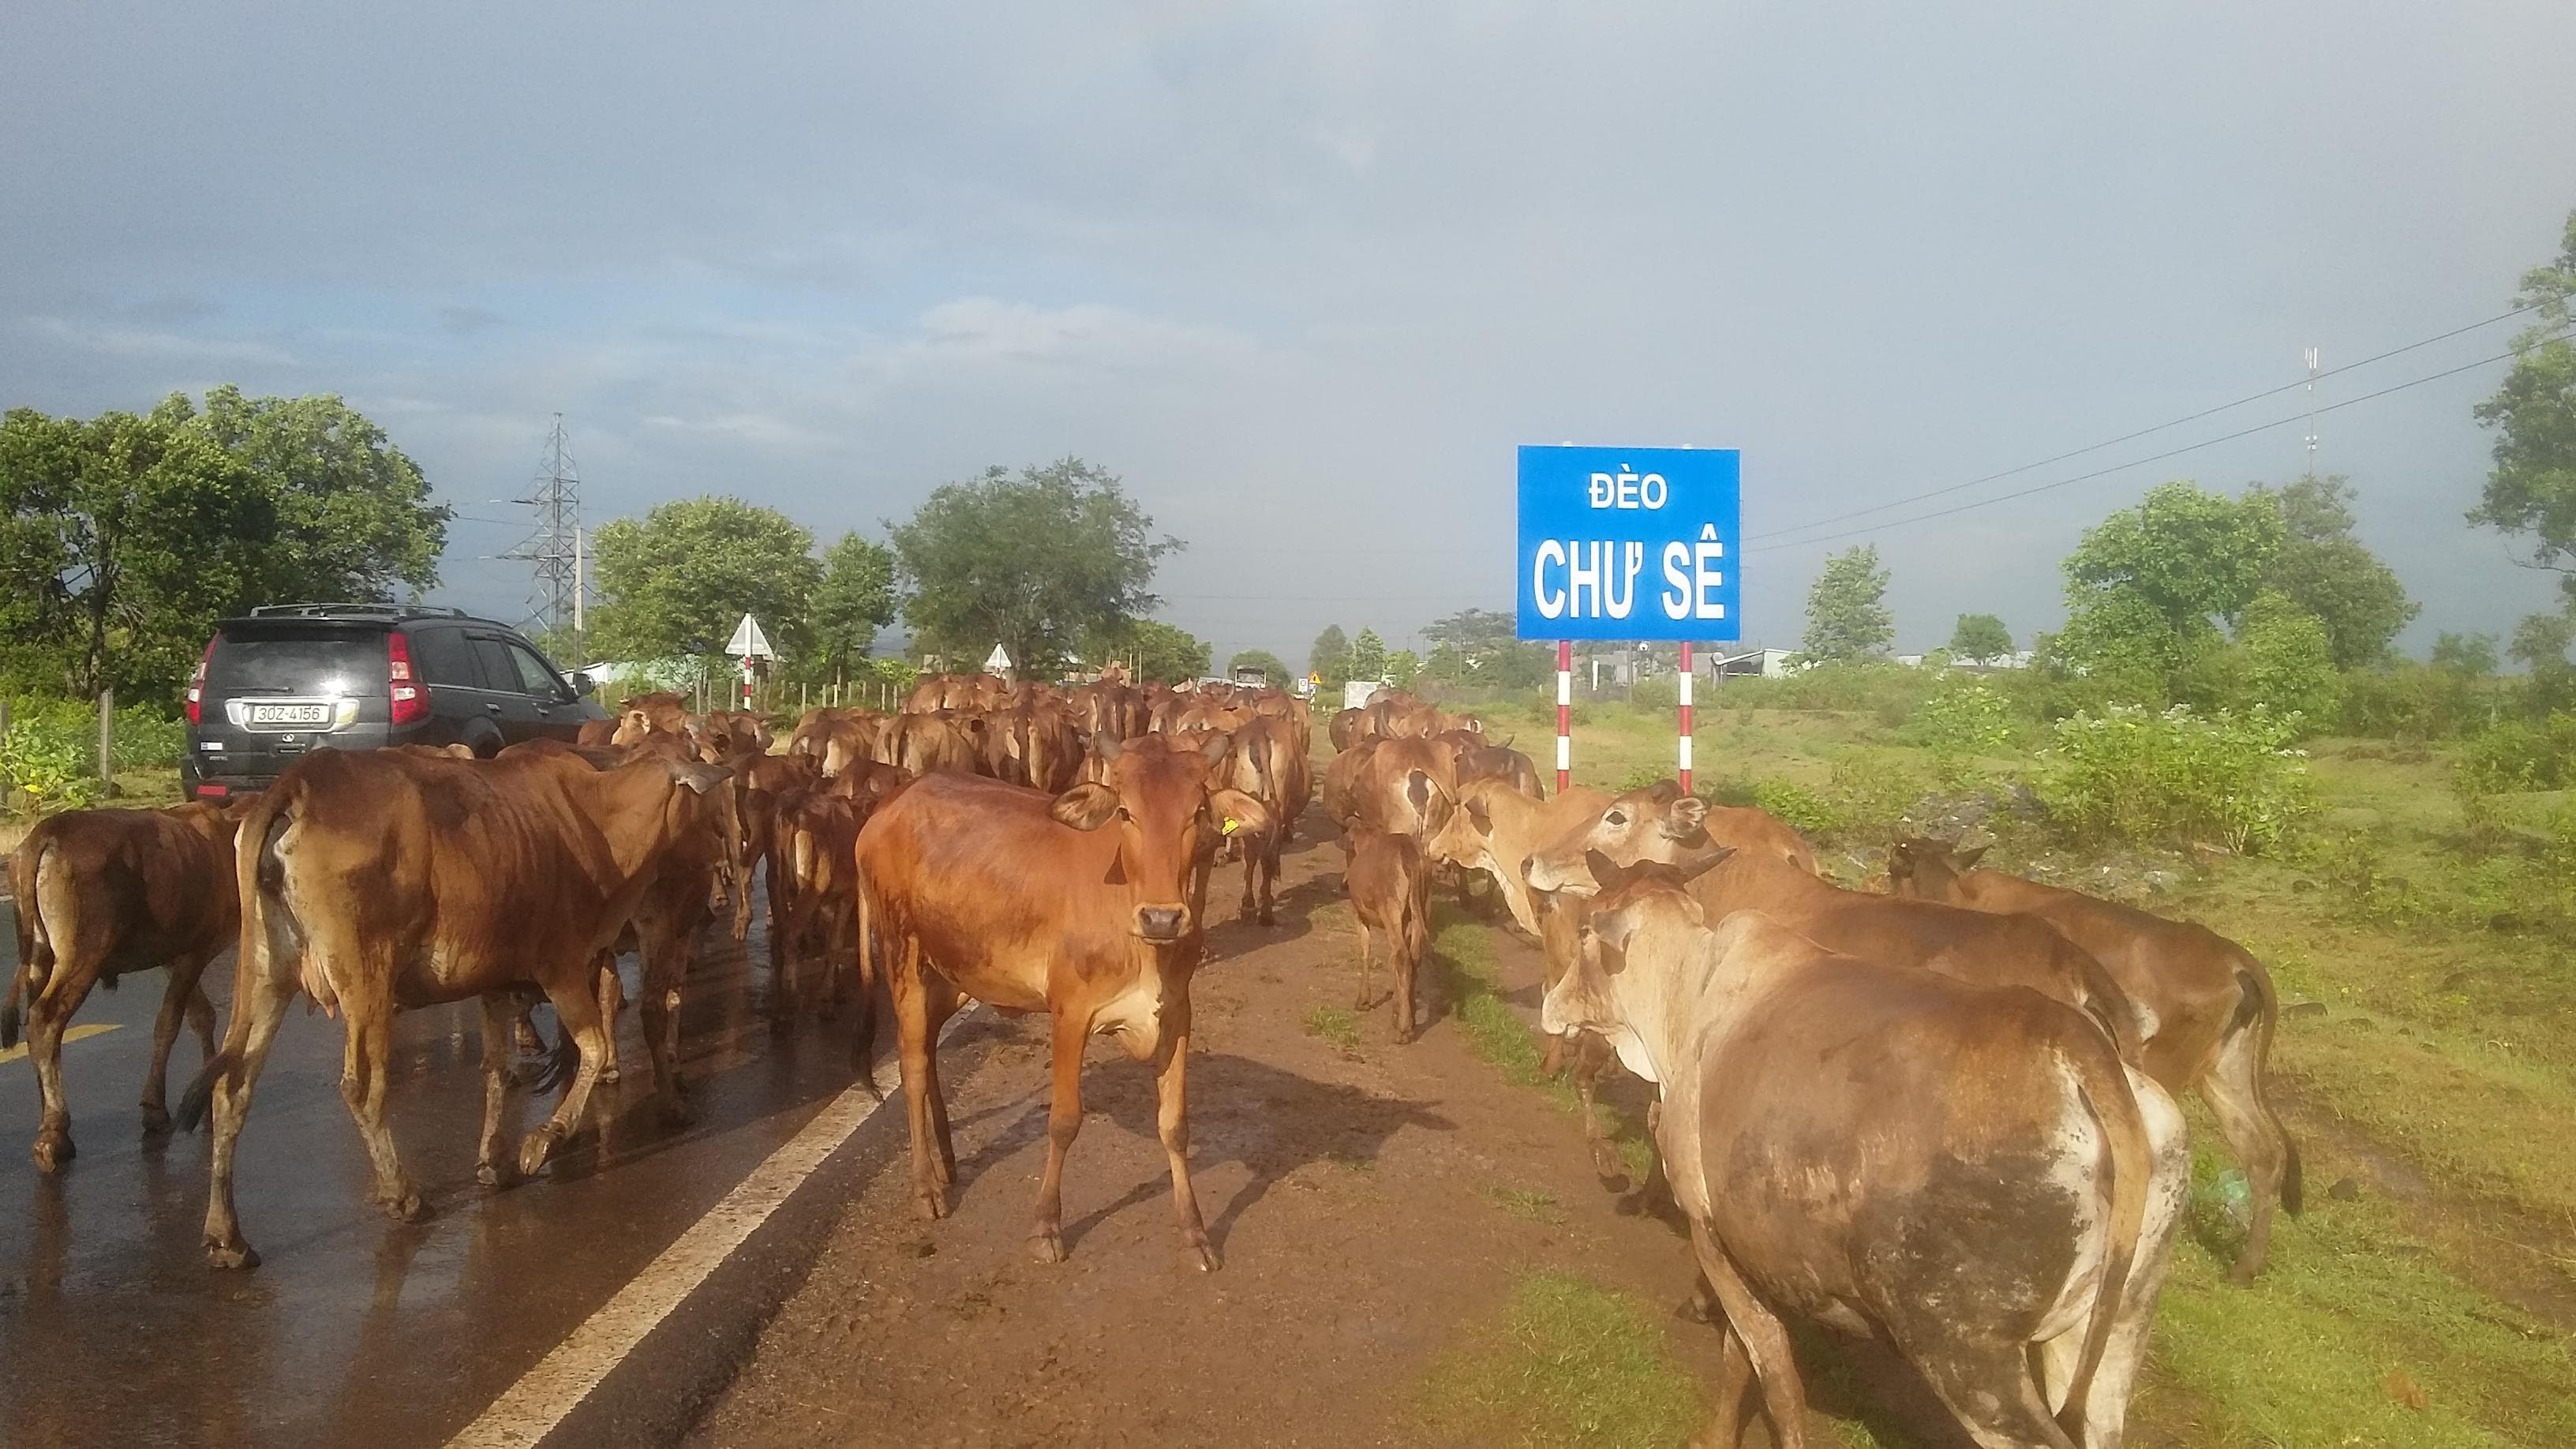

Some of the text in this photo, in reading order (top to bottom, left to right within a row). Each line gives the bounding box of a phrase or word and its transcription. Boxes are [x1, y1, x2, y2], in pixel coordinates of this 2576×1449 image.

[1588, 463, 1668, 510] ĐÈO
[1533, 522, 1725, 620] CHƯ SÊ
[258, 707, 320, 721] 30Z-4156
